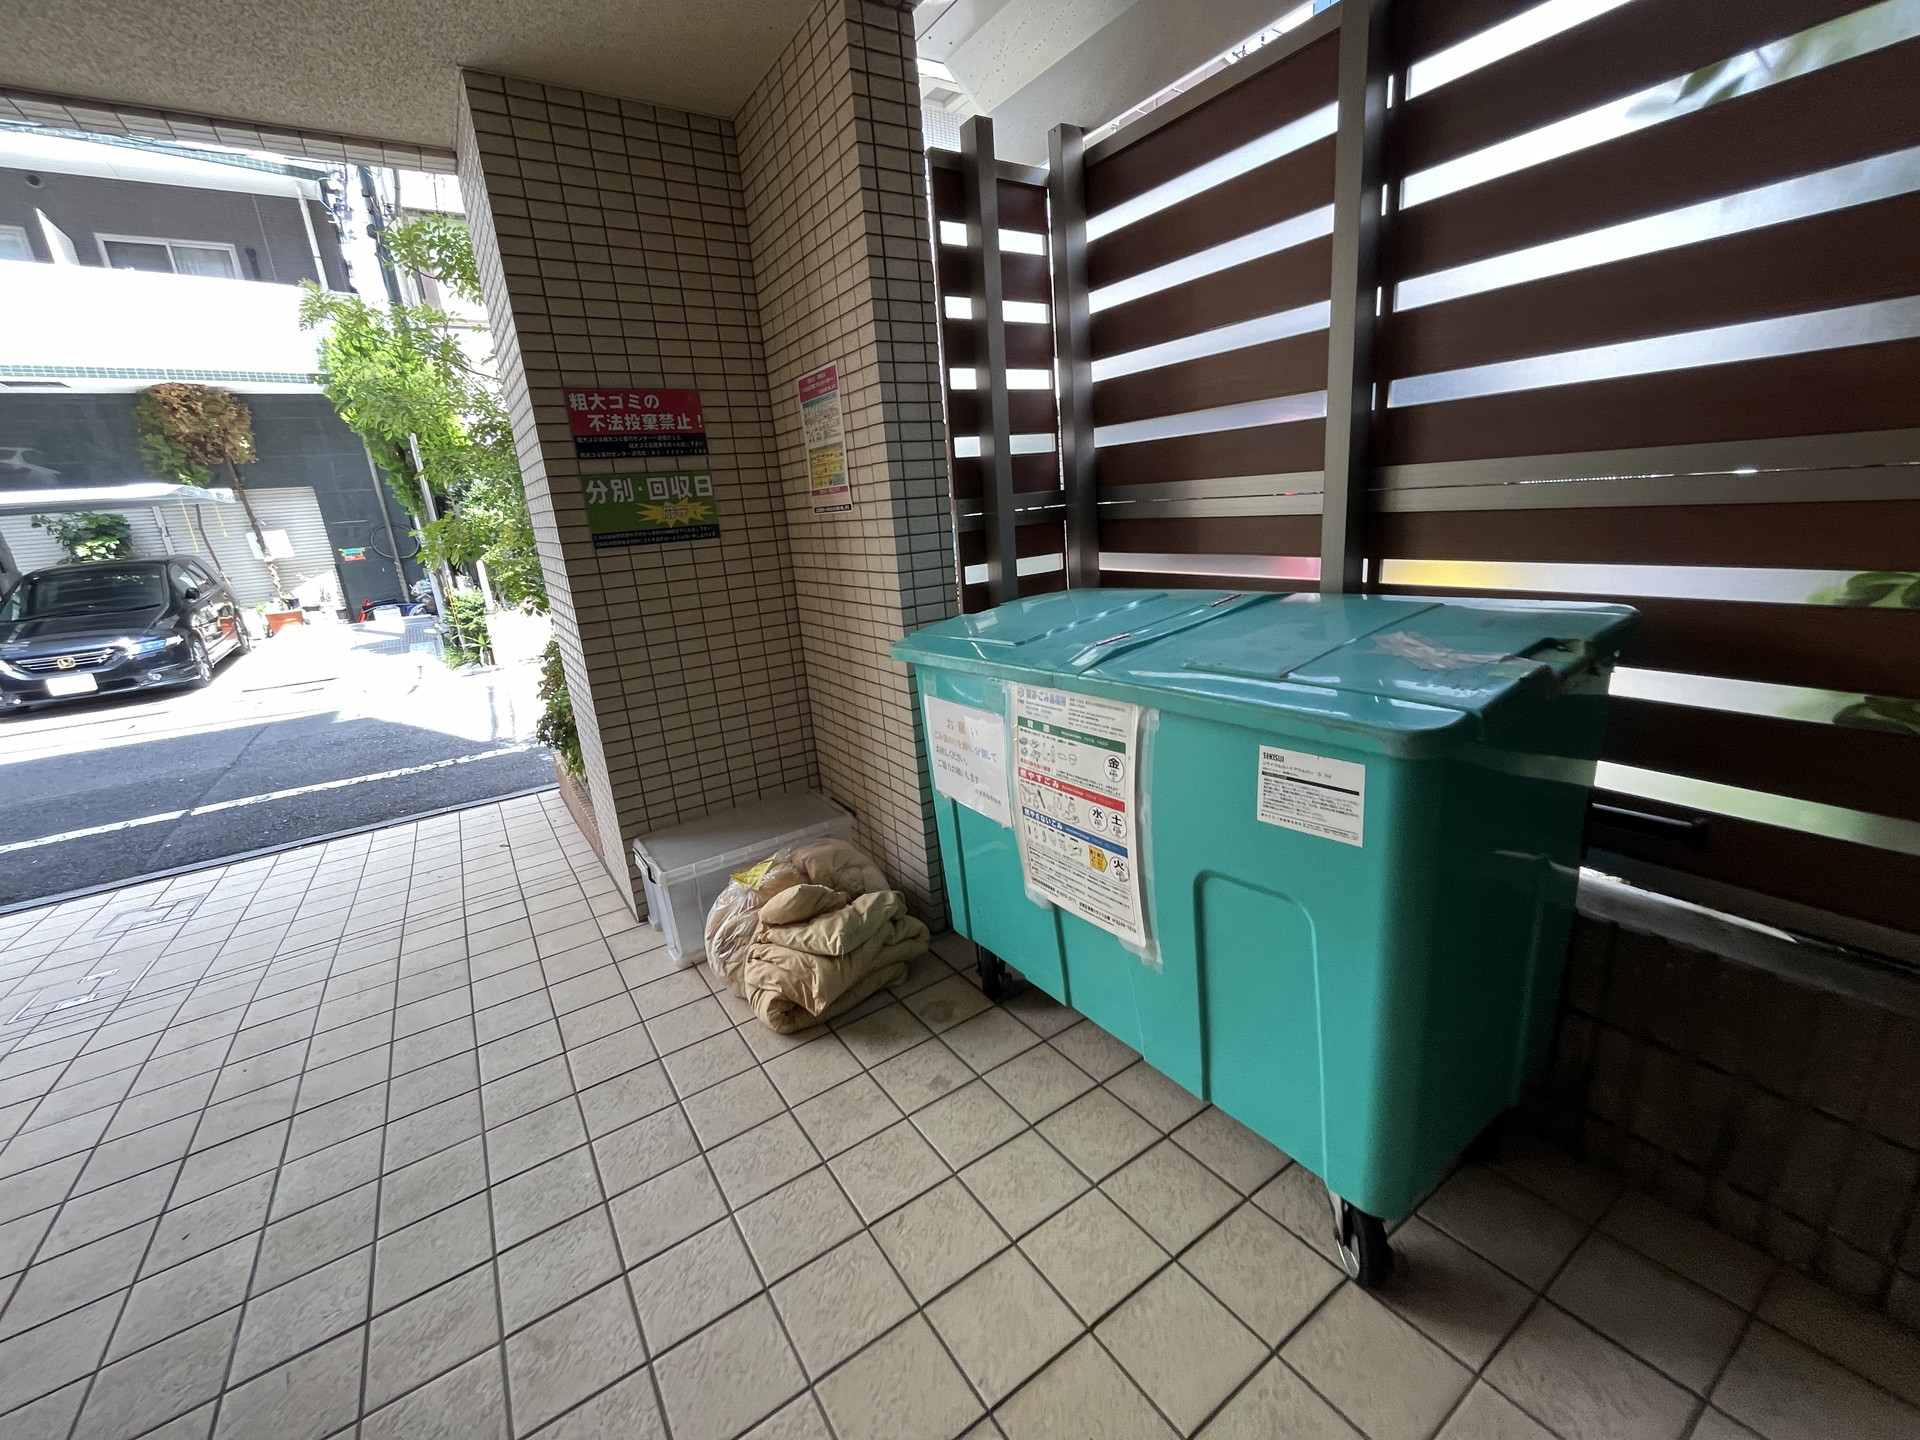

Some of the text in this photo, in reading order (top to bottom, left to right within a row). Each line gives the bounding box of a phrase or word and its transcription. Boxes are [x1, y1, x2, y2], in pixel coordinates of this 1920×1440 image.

[568, 393, 660, 411] 粗大ゴミの
[586, 475, 713, 505] 分別・回収日
[1107, 758, 1120, 770] 金
[1092, 808, 1103, 819] 水
[1111, 815, 1122, 827] 土
[1113, 859, 1125, 871] 火
